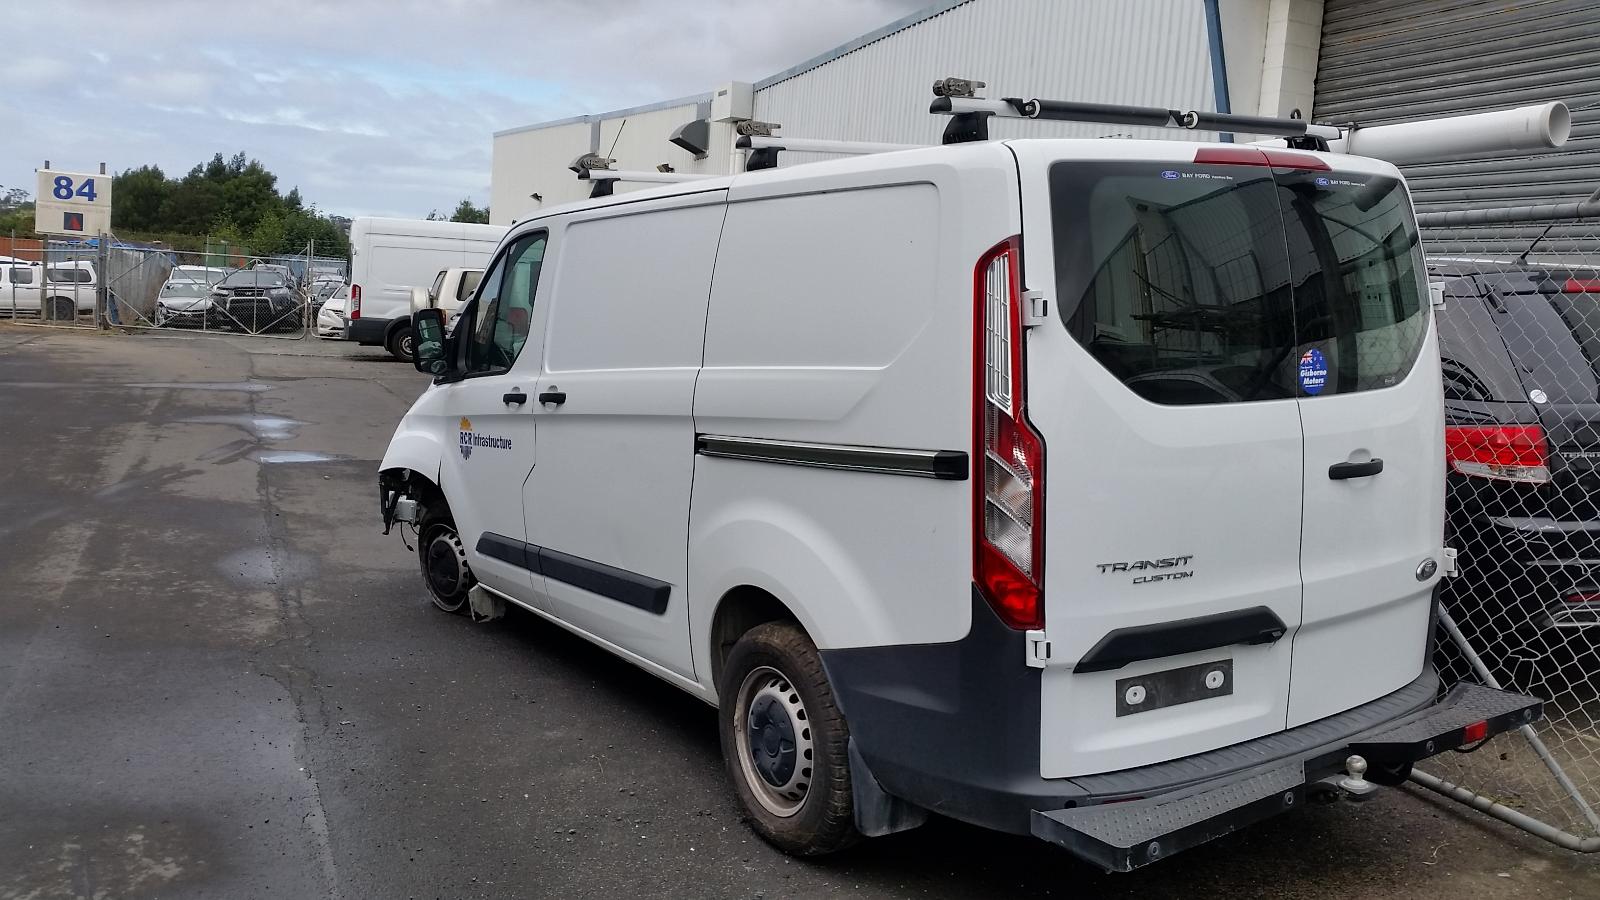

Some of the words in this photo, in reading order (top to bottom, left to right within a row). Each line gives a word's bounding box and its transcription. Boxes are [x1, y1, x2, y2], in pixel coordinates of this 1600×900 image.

[53, 175, 97, 202] 84
[1300, 368, 1327, 377] Gisborne
[1303, 377, 1325, 385] Motors
[459, 431, 473, 445] RCR
[473, 433, 512, 450] Infrastructure
[1096, 554, 1194, 574] TRANSIT
[1132, 570, 1194, 585] CUSTOM
